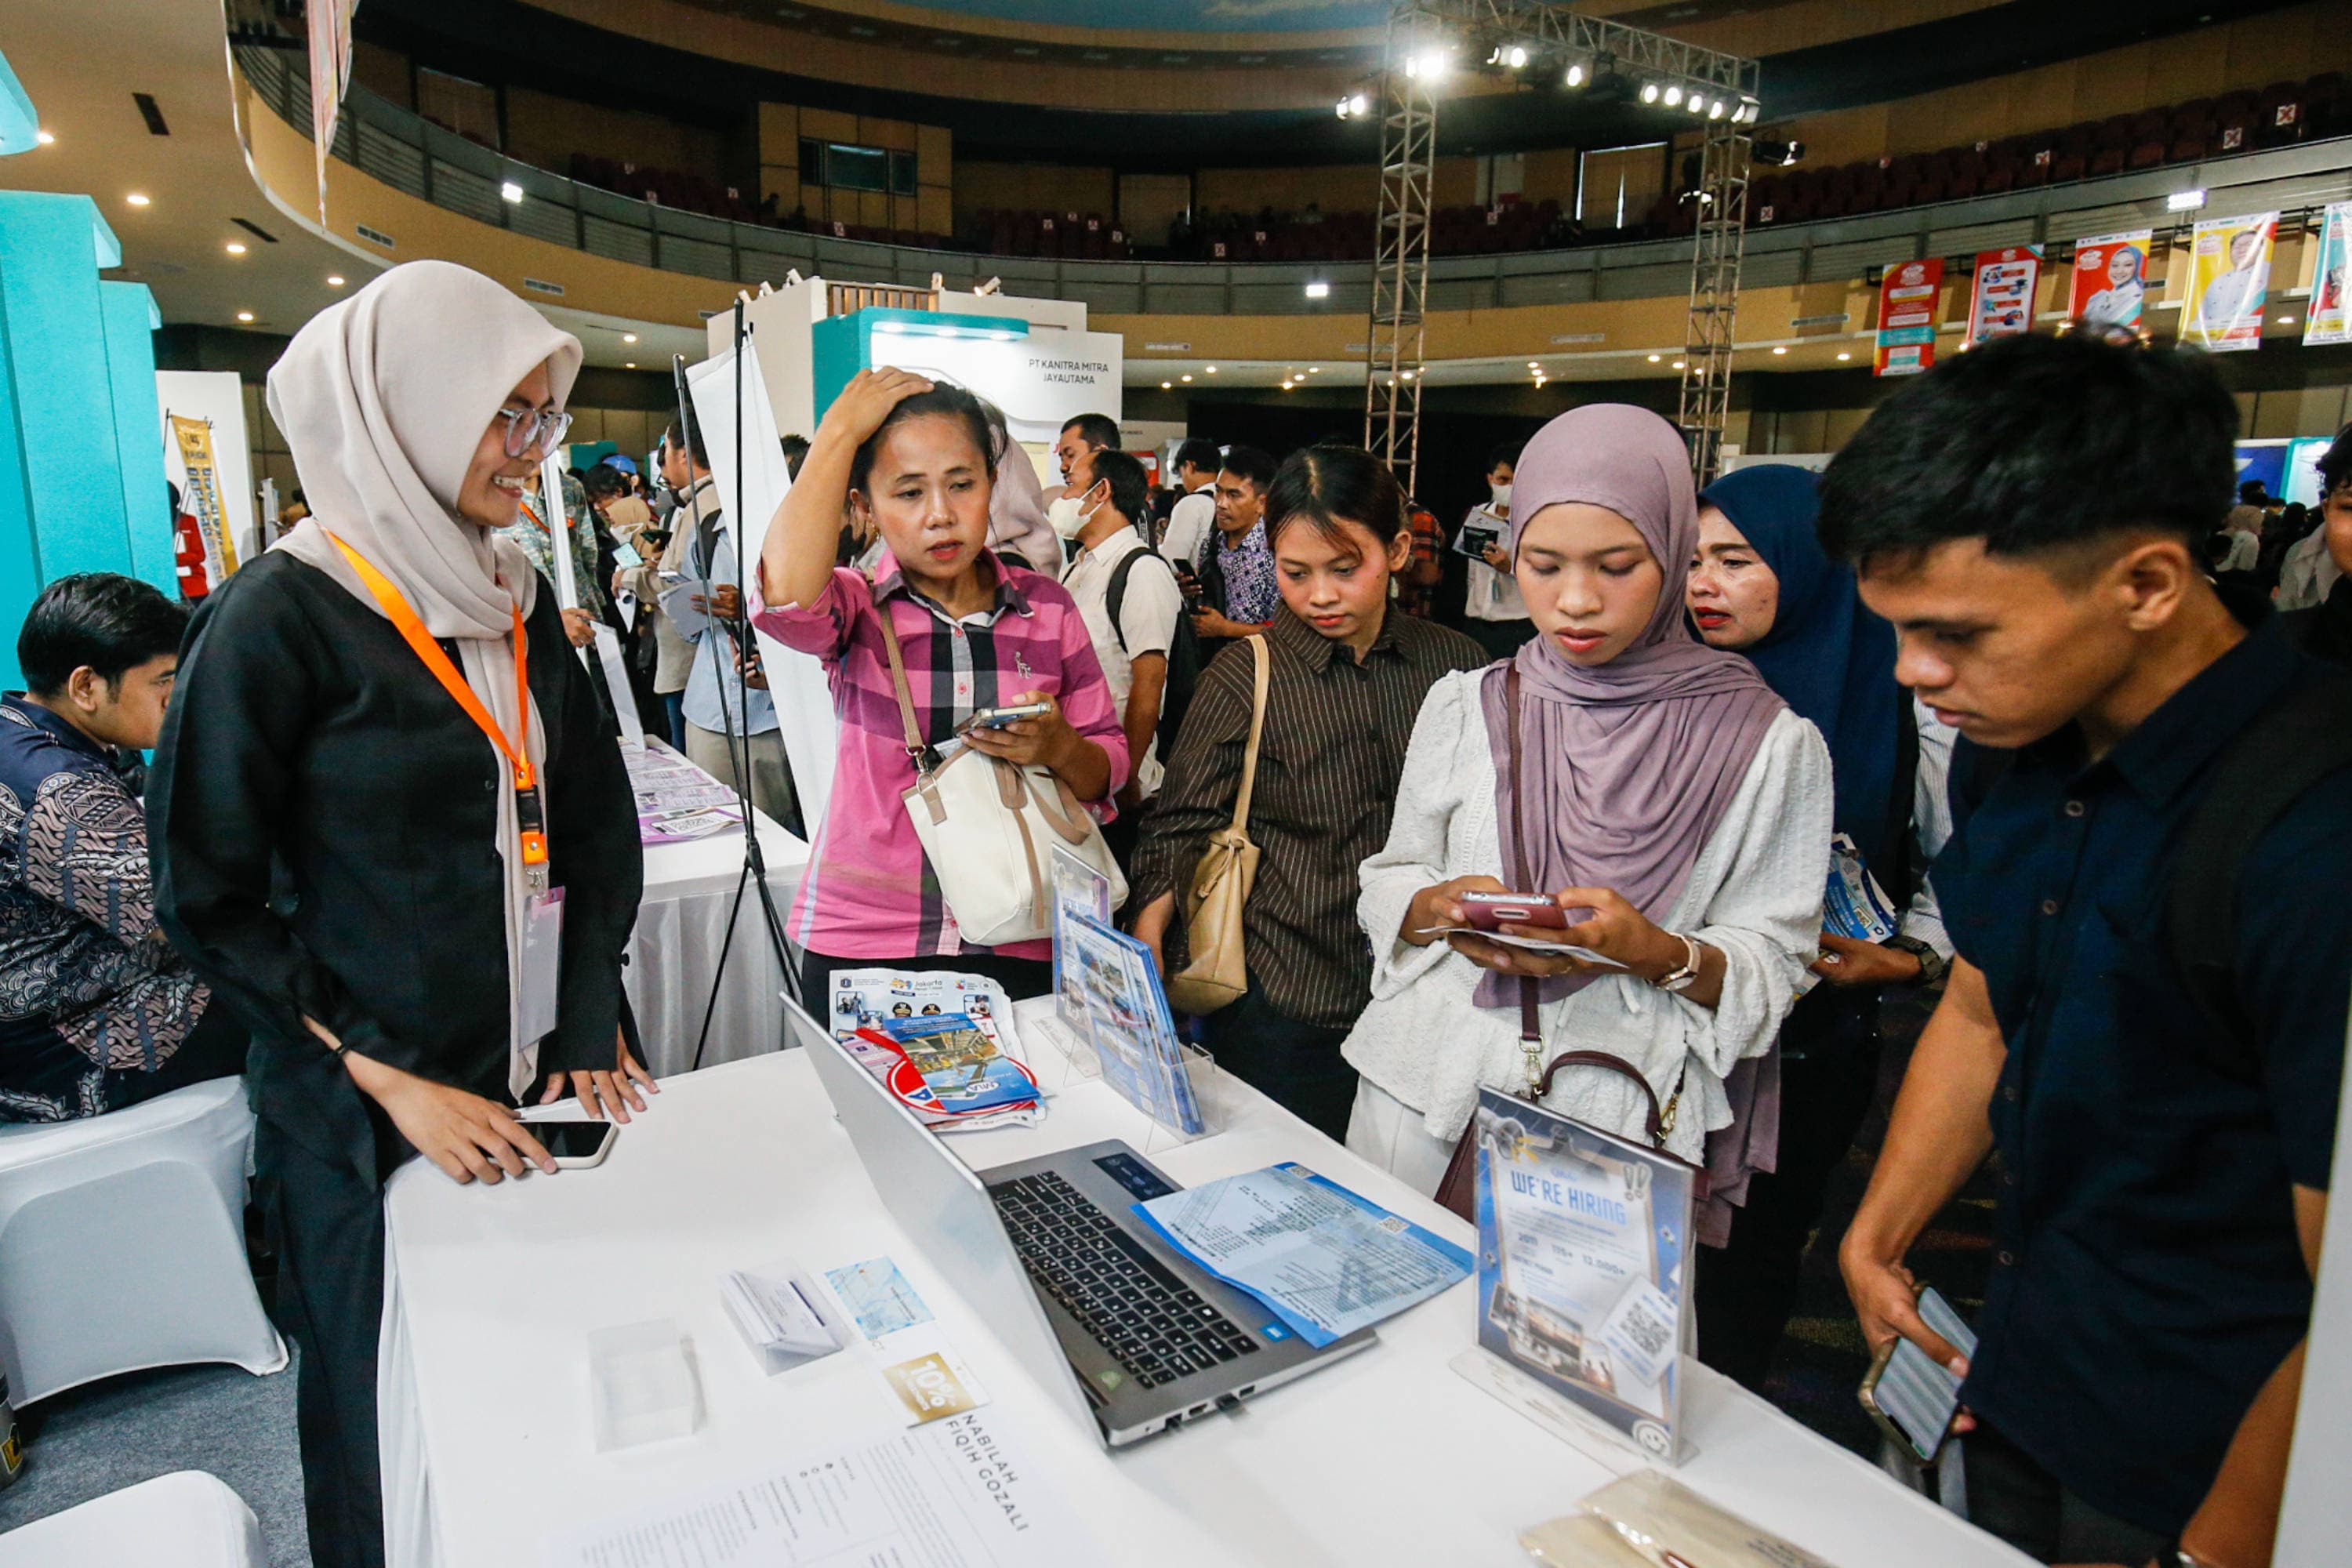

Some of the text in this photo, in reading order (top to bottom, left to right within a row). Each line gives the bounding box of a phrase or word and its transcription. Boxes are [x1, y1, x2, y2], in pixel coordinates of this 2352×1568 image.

[1029, 359, 1109, 372] PT KANITRA MITRA
[1044, 373, 1095, 384] JAYAUTAMA
[1511, 1170, 1563, 1206] WE'RE
[1568, 1188, 1628, 1225] HIRING
[910, 1359, 956, 1408] 10%
[963, 1414, 1019, 1483] NABILAH
[946, 1420, 1029, 1532] FIQIH GOZALI
